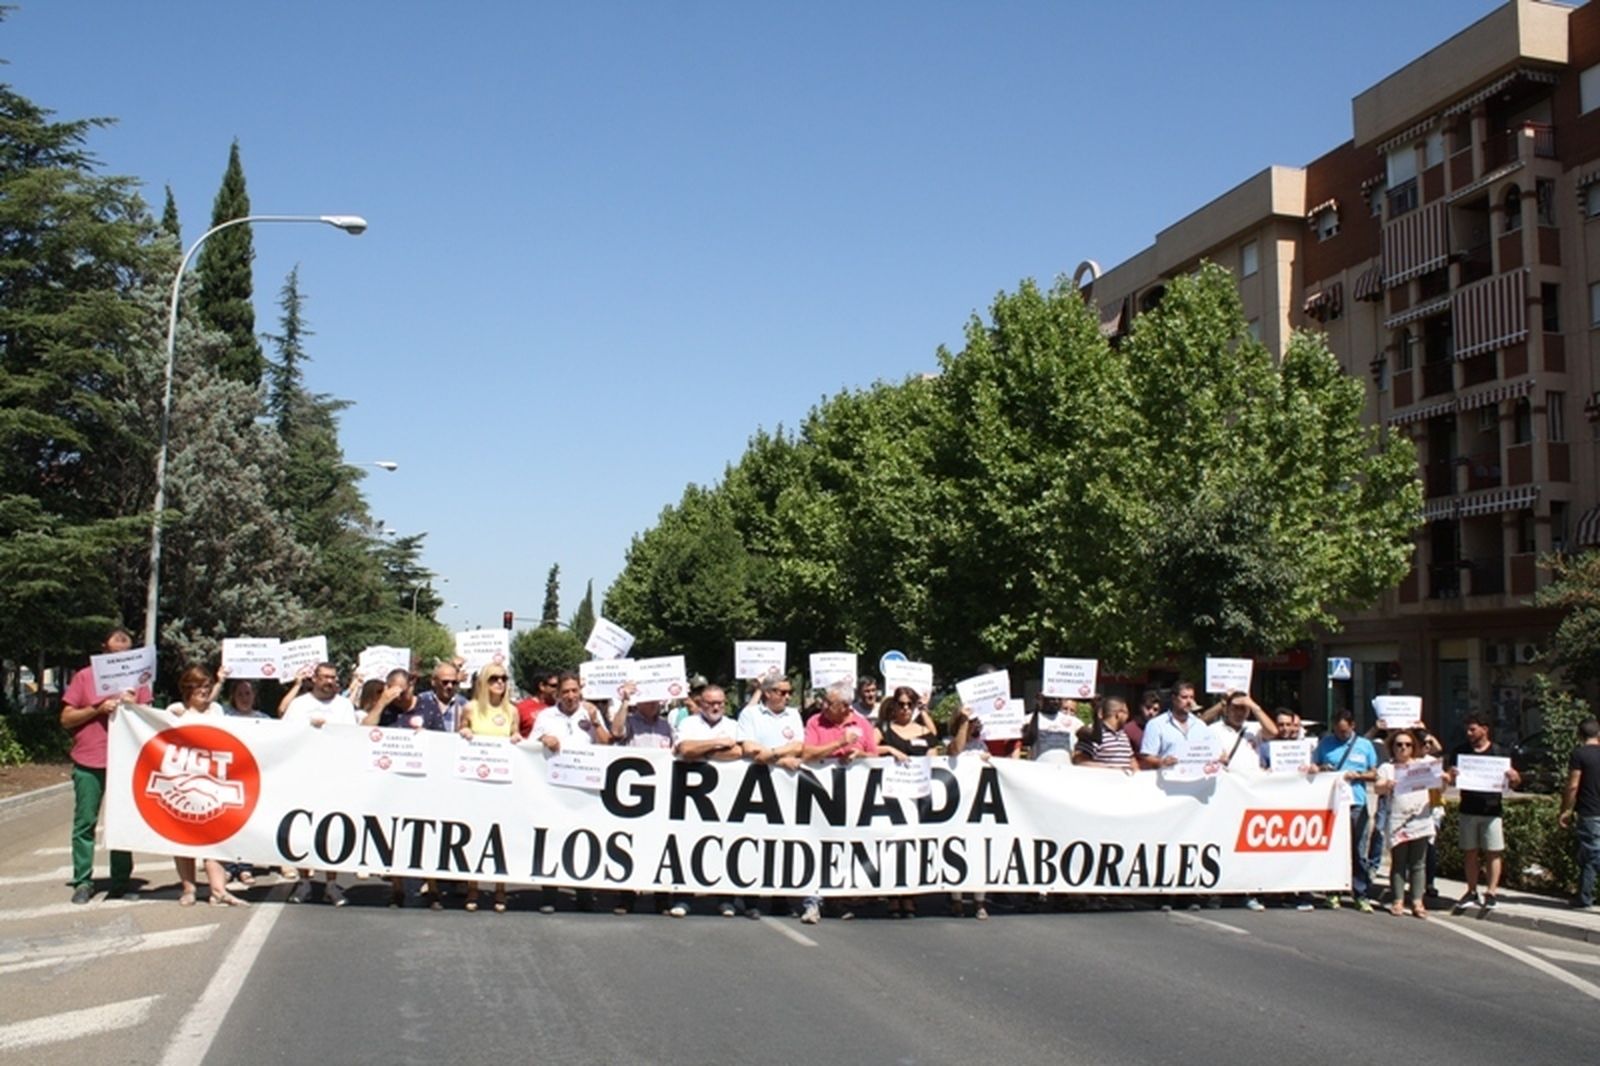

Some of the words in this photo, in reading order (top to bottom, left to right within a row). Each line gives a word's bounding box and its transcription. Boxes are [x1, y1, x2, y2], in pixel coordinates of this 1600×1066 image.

[162, 743, 233, 779] UGT
[599, 757, 1008, 826] GRANADA
[277, 809, 508, 876] CONTRA
[531, 827, 634, 883] LOS
[653, 834, 968, 889] ACCIDENTES
[983, 837, 1221, 888] LABORALES
